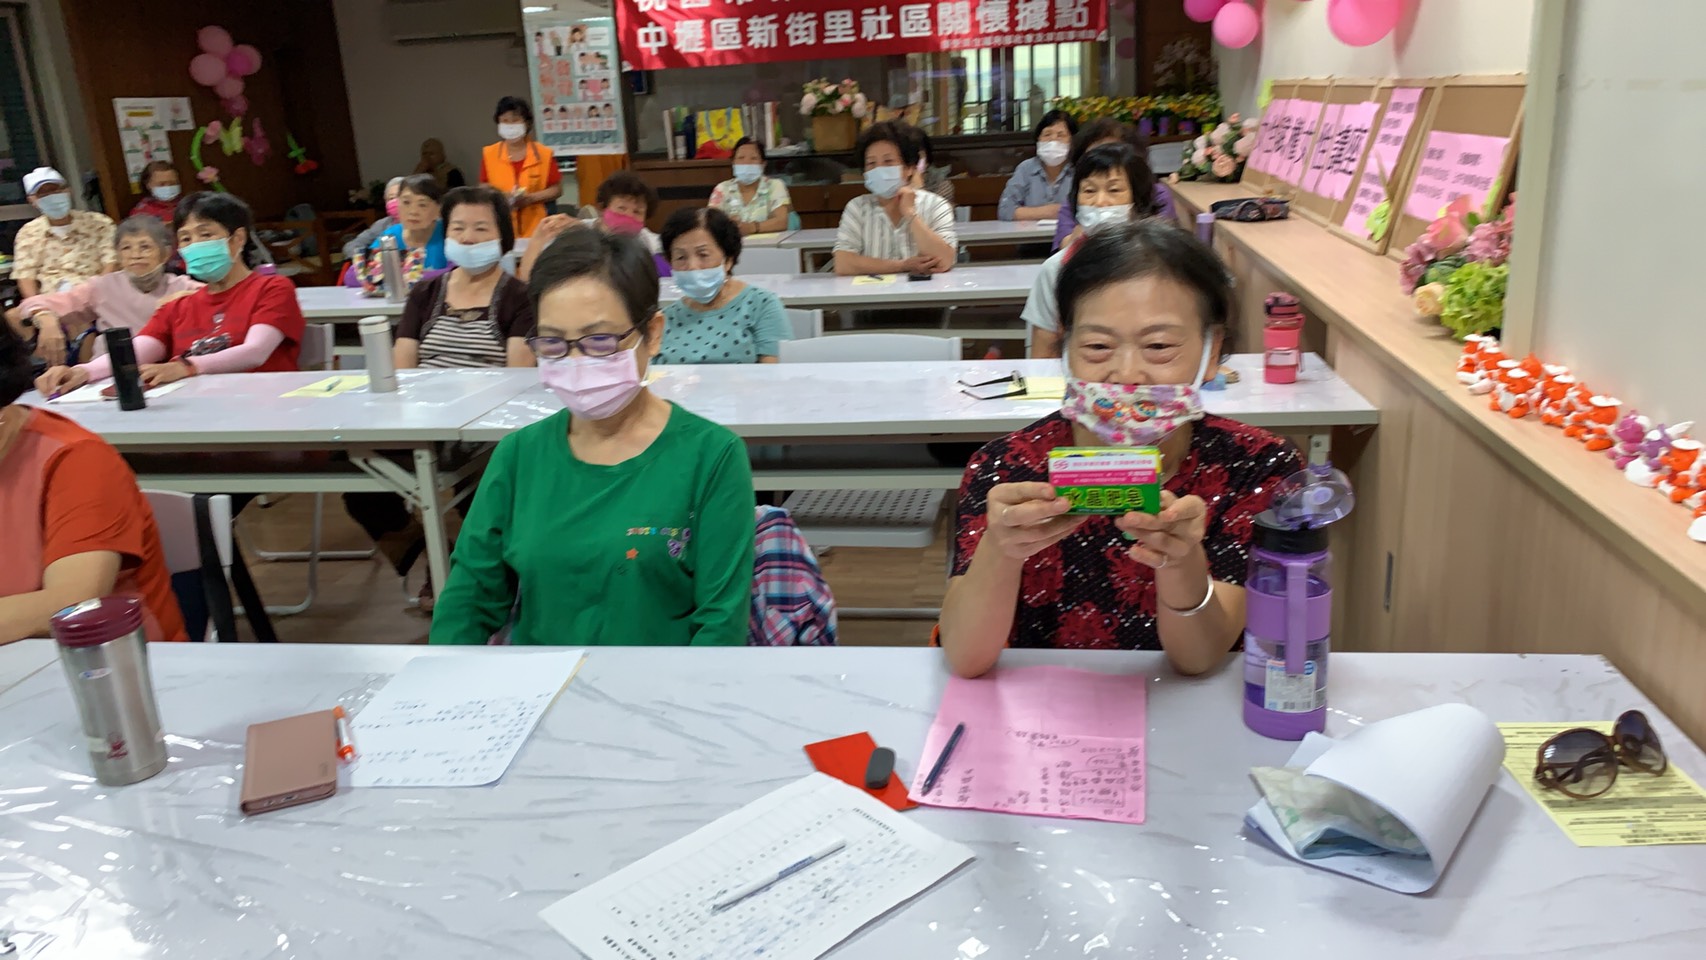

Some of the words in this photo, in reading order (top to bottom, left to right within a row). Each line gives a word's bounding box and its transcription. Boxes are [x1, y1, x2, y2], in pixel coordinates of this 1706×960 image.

[636, 0, 1090, 55] 中壢區新街里社區關懷據點
